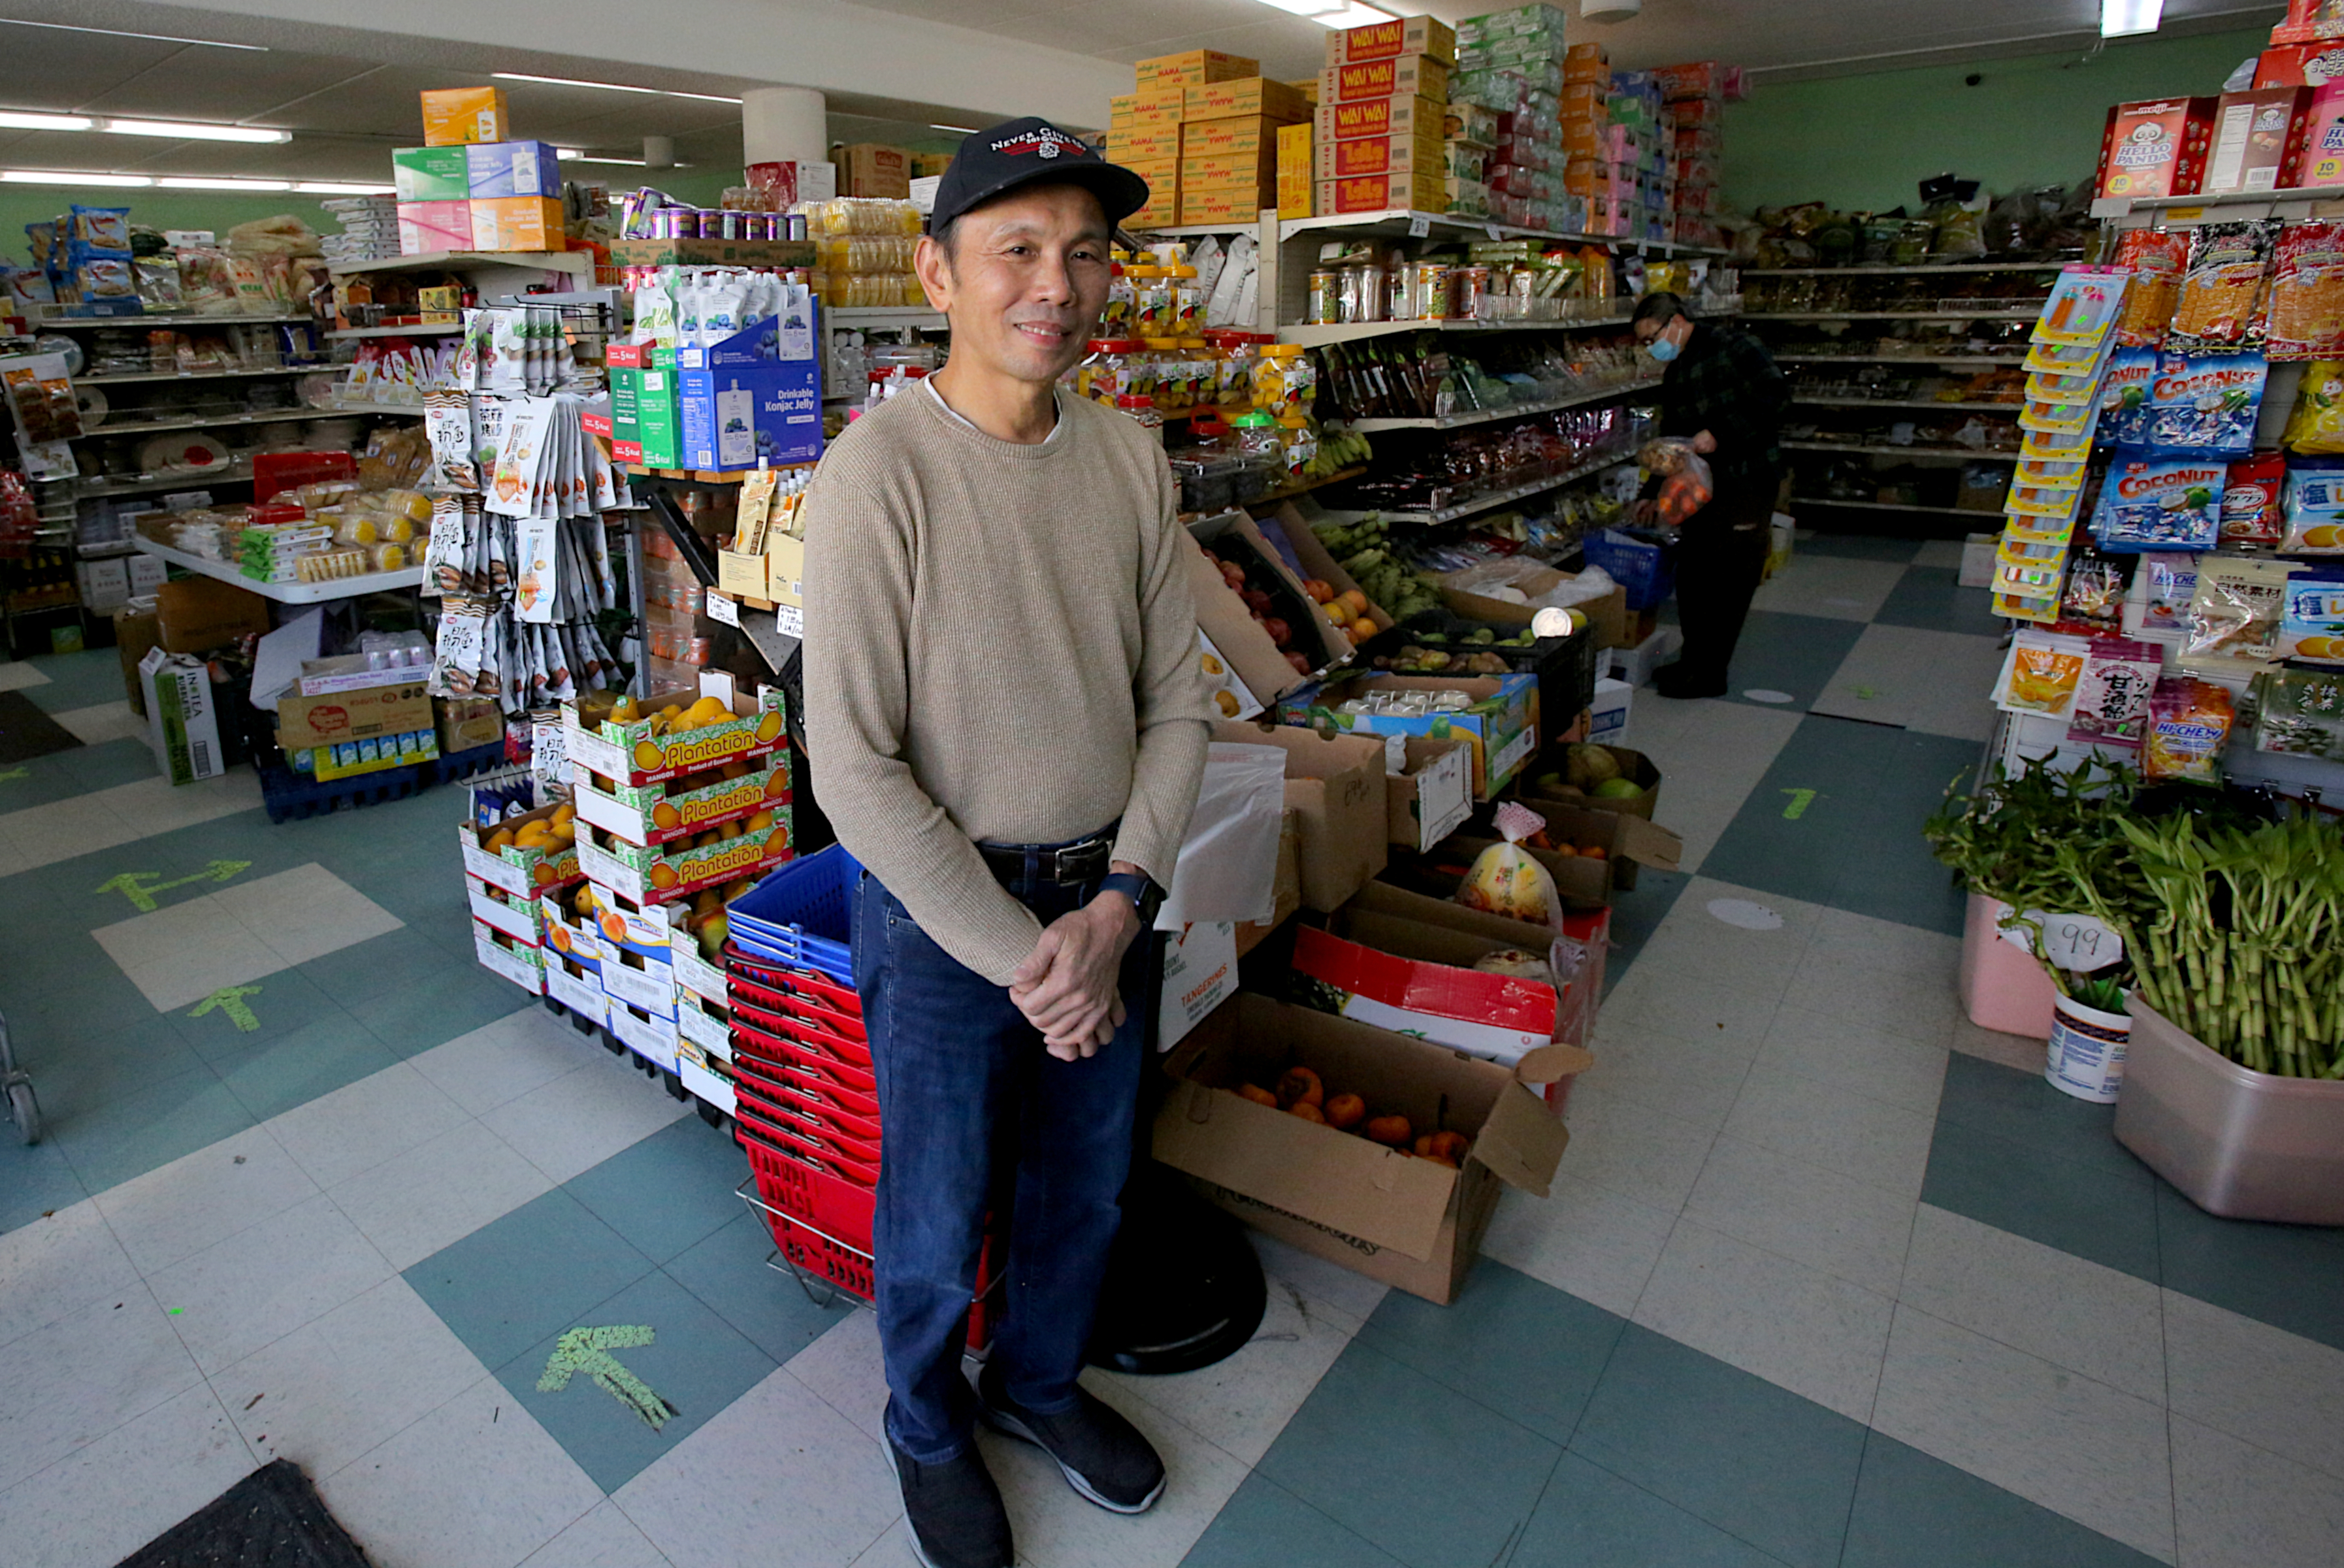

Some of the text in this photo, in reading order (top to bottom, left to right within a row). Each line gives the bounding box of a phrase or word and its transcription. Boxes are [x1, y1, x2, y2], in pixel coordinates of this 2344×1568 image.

[1350, 24, 1401, 48] WAI WAI
[1158, 67, 1180, 77] MAMA
[1343, 65, 1392, 87] WAI WAI
[1134, 104, 1158, 113] MAMA
[1339, 103, 1386, 125] WAI WAI
[2138, 103, 2168, 114] meiji
[990, 131, 1035, 150] NEVER
[2118, 143, 2172, 157] HELLO
[2113, 154, 2173, 166] PANDA
[2320, 162, 2334, 172] 10
[2115, 178, 2127, 187] 10
[620, 351, 626, 361] 5
[665, 355, 670, 364] 6
[2107, 367, 2150, 384] ONUT
[2154, 370, 2262, 400] COCONUT
[777, 388, 814, 400] Drinkable
[765, 398, 814, 412] Konjac Jelly
[594, 420, 600, 430] 5
[625, 446, 630, 457] 5
[655, 453, 660, 463] 6
[2118, 470, 2219, 499] COCONUT
[2155, 572, 2197, 586] HI-CHE
[177, 676, 189, 704] BUBBLE
[2157, 723, 2223, 739] HI-CHEW
[747, 745, 774, 757] MANGOS
[688, 762, 707, 772] Product
[713, 756, 733, 766] Ecuador
[646, 770, 675, 783] MANGOS
[760, 797, 783, 809] MANGOS
[704, 817, 720, 826] Product
[726, 811, 743, 819] Ecuador
[662, 827, 687, 840] MANGOS
[758, 856, 782, 868] MANGOS
[724, 870, 741, 879] Ecuador
[659, 887, 685, 900] MANGOS
[1165, 953, 1180, 971] OUNT
[1181, 963, 1228, 1007] TANGERINES
